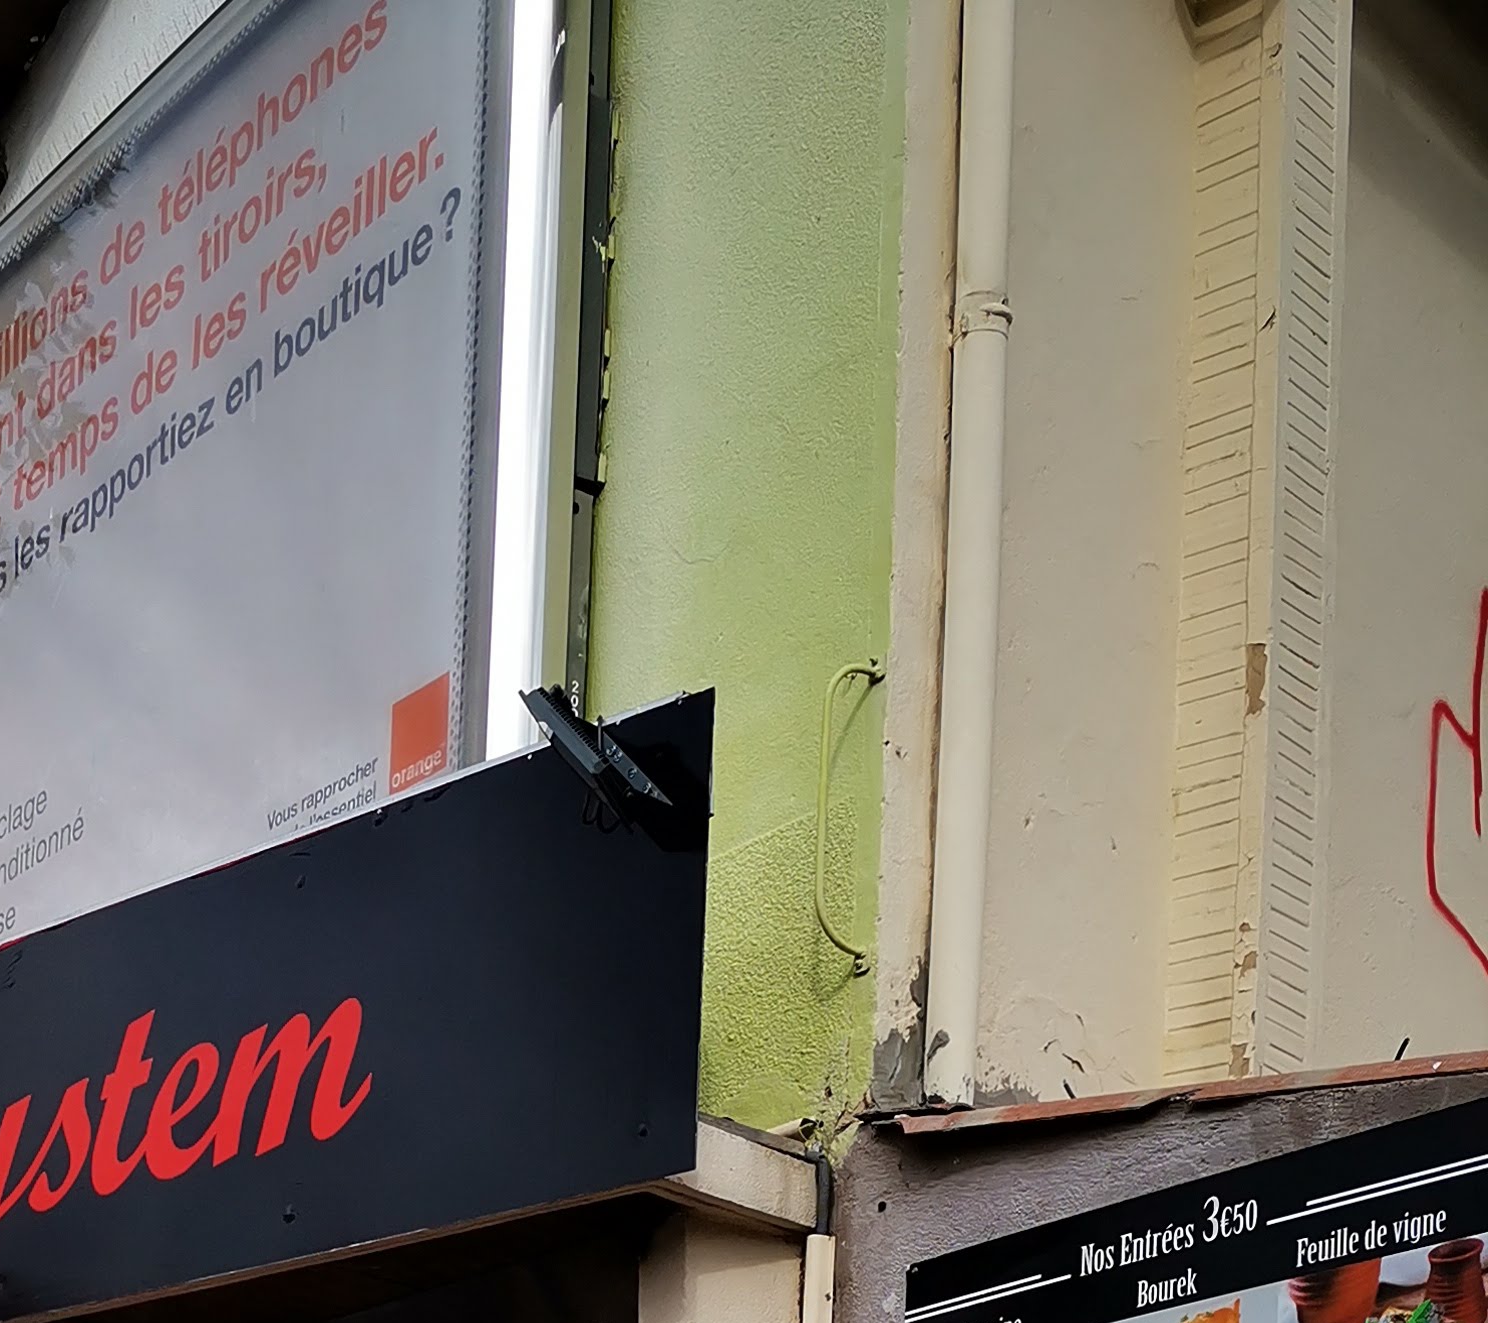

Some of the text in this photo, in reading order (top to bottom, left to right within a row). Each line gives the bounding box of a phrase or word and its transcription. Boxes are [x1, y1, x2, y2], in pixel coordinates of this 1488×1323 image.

[98, 220, 146, 286] de
[157, 0, 388, 236] téléphones
[12, 396, 120, 511] temps
[129, 349, 179, 416] de
[190, 290, 248, 371] les
[258, 126, 445, 314] réveiller.
[36, 319, 118, 420] dans
[128, 263, 186, 341] les
[197, 147, 328, 284] tiroirs,
[13, 523, 51, 579] les
[58, 391, 216, 544] rapportiez
[225, 357, 263, 417] en
[266, 756, 380, 831] Vous rapprocher
[390, 748, 444, 789] orange
[1078, 1194, 1259, 1278] Nos Entrées 3€50
[1295, 1208, 1448, 1269] Feuille de vigne
[1135, 1266, 1199, 1309] Bourek
